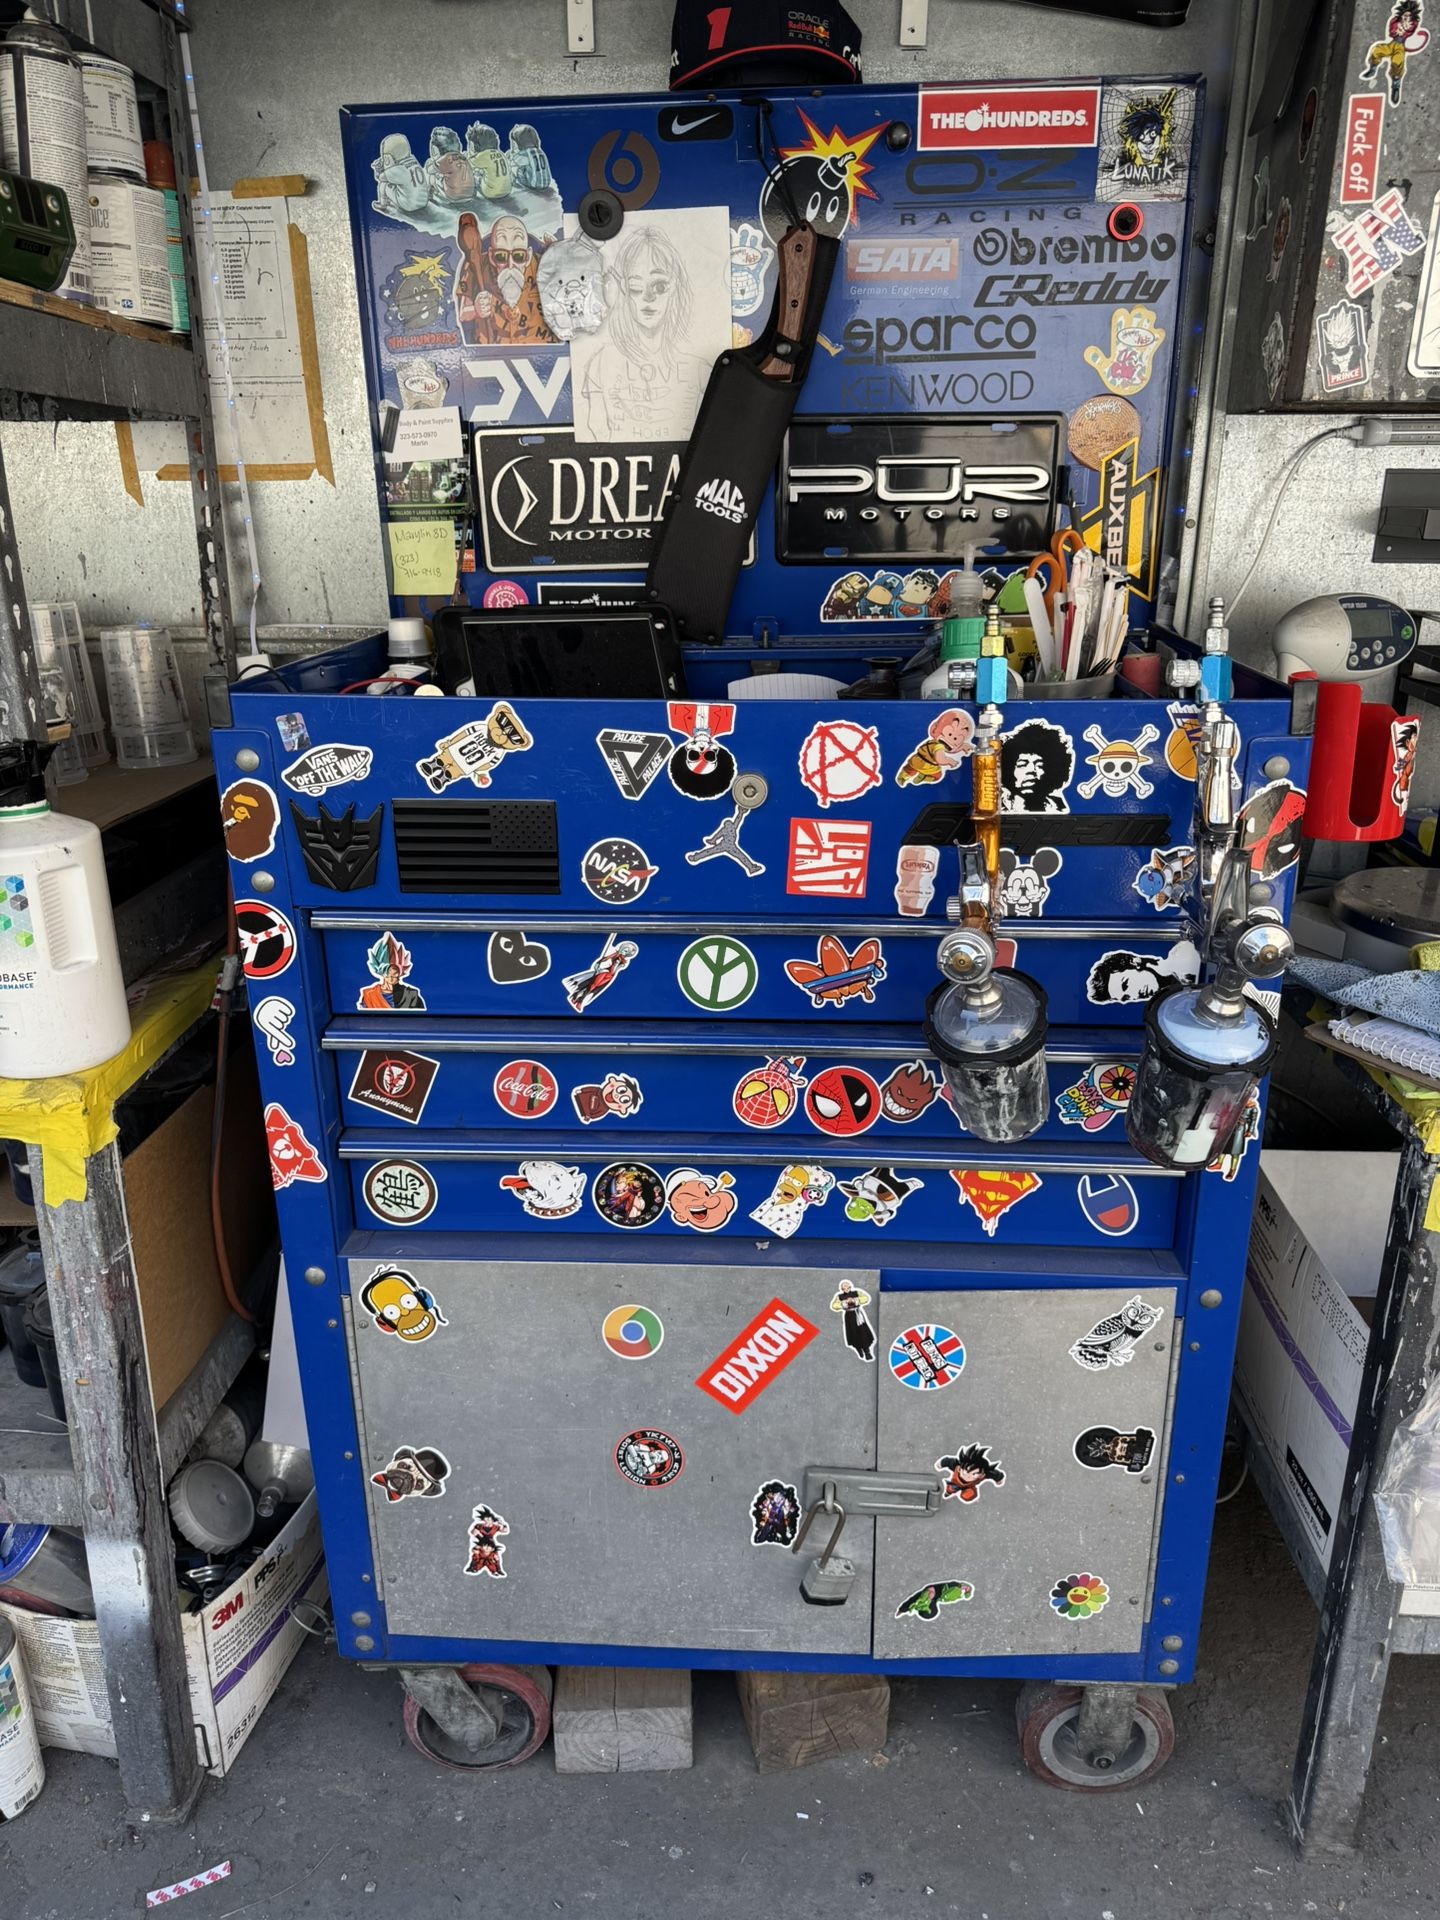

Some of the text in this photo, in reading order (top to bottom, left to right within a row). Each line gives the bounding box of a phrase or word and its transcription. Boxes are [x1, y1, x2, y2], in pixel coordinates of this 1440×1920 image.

[707, 6, 732, 50] 1
[788, 10, 830, 28] ORACLE
[788, 32, 830, 48] RACING
[930, 112, 965, 129] THE
[1347, 107, 1374, 194] Fuck off
[901, 206, 1082, 226] RACING
[855, 247, 951, 273] SATA
[1008, 228, 1176, 266] brembo
[850, 284, 950, 298] German Engineering
[842, 313, 1037, 365] sparco
[840, 370, 1034, 407] KENWOOD
[1330, 367, 1362, 385] PRINCE
[697, 478, 745, 510] MAC
[694, 498, 745, 525] TOOLS
[825, 507, 1009, 520] MOTORS
[1105, 458, 1128, 581] AUXBEA
[549, 528, 652, 541] MOTOR
[613, 732, 647, 744] PALACE
[305, 749, 338, 770] VANS
[314, 763, 341, 782] THE
[608, 757, 630, 786] PALACE
[642, 752, 664, 783] PALACE
[589, 852, 641, 892] NASA
[358, 1087, 415, 1115] Anonymous
[709, 1309, 804, 1402] DIXXON
[619, 1461, 647, 1485] LEGION
[212, 1556, 276, 1631] 3M PPS
